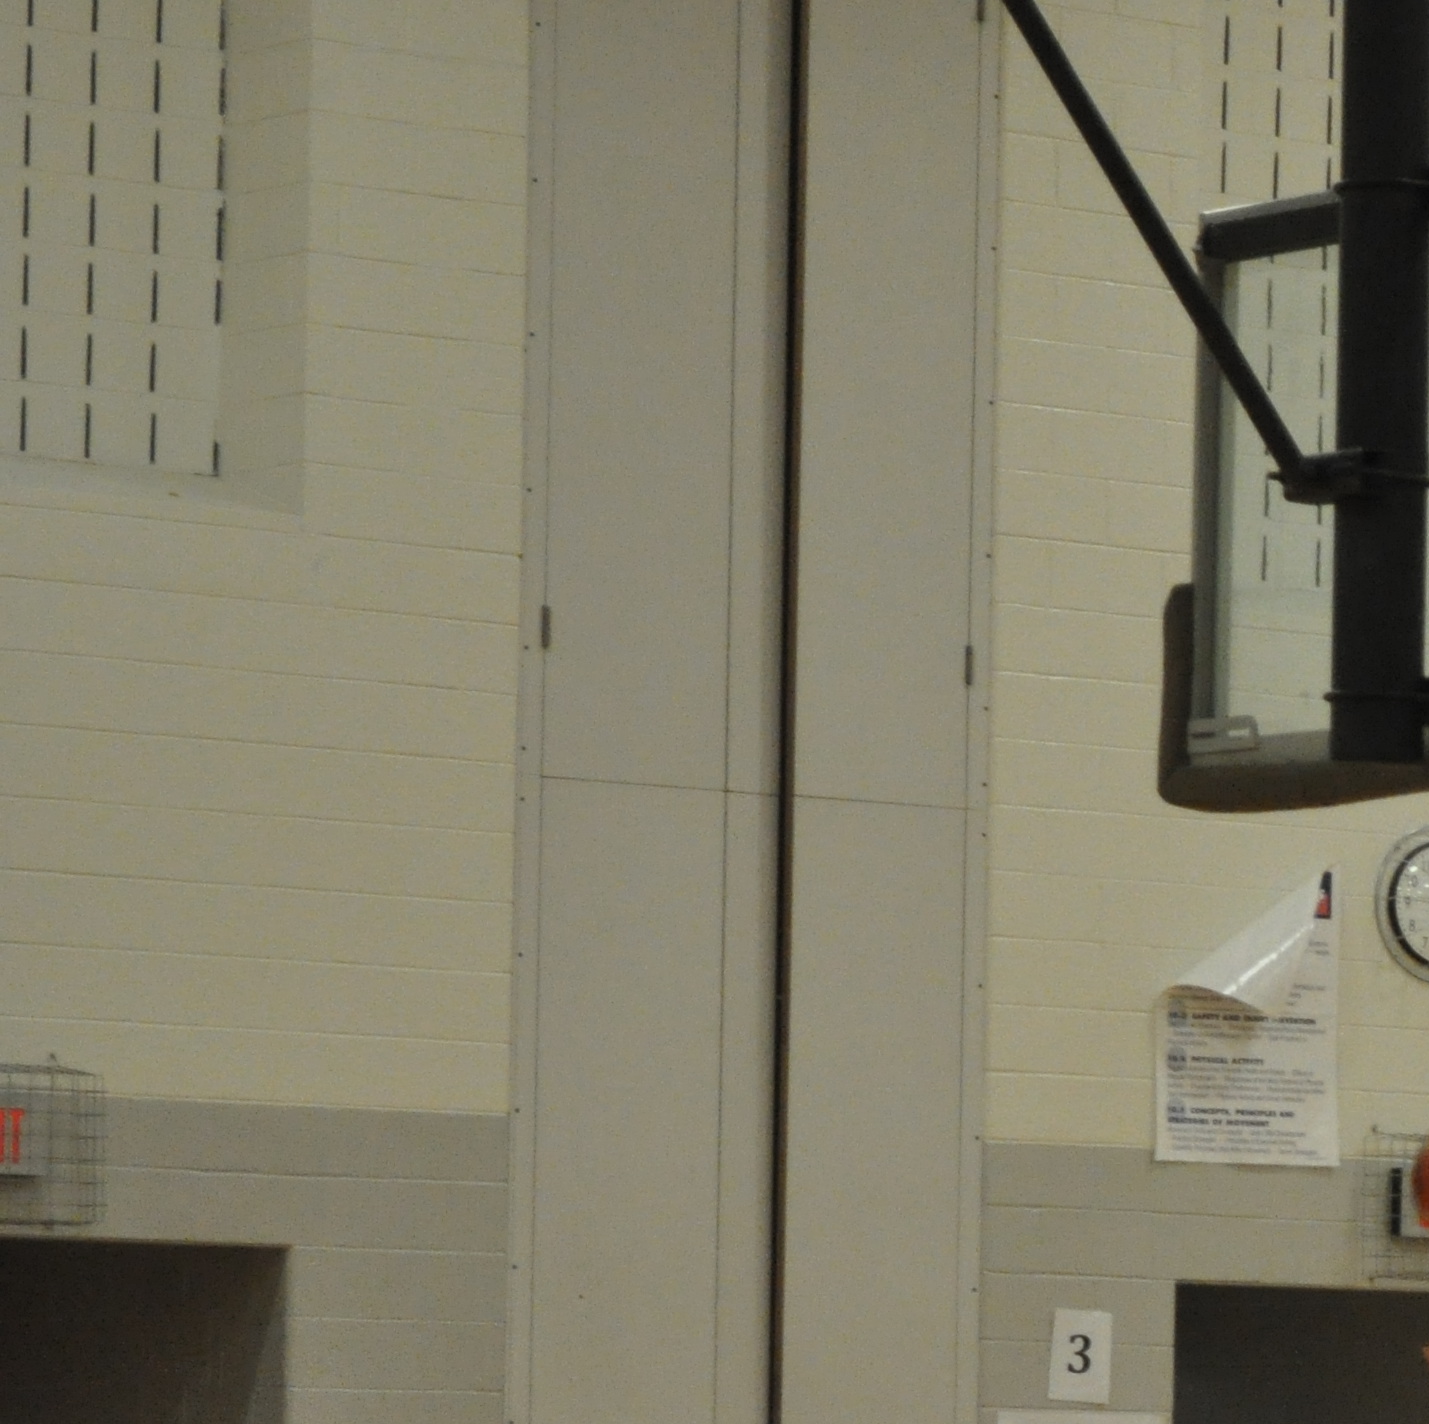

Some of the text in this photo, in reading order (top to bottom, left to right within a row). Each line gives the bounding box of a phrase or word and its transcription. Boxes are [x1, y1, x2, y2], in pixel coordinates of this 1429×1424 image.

[1408, 919, 1416, 931] 8
[1421, 936, 1429, 948] 7
[1191, 1055, 1228, 1065] PHYSICAL
[1231, 1057, 1264, 1066] ACTIVITY
[1226, 1119, 1270, 1127] MOVEMENT
[1067, 1334, 1092, 1374] 3
